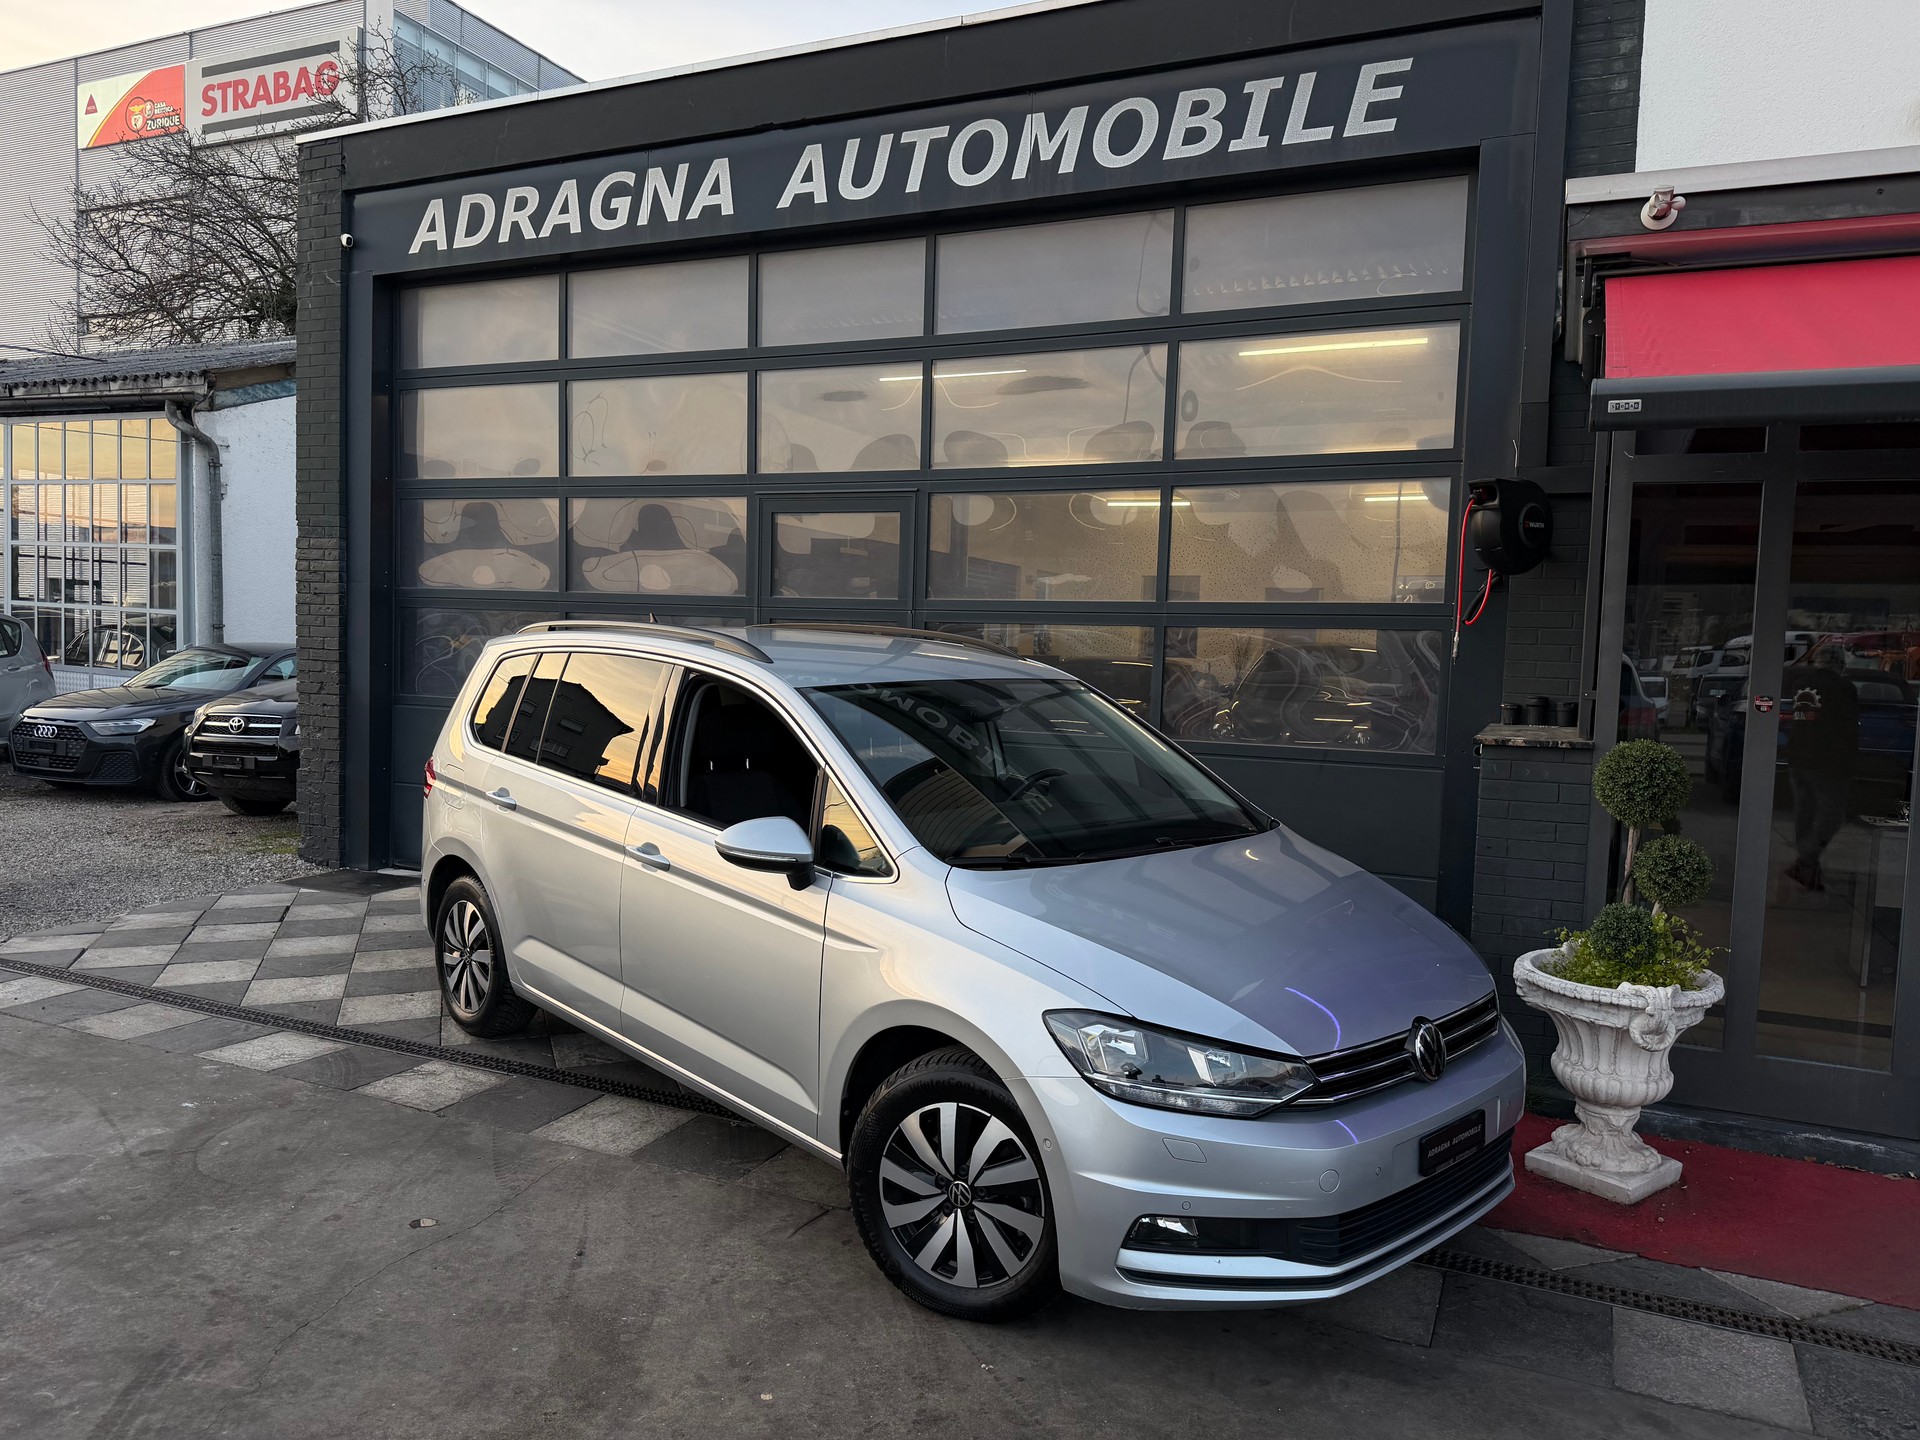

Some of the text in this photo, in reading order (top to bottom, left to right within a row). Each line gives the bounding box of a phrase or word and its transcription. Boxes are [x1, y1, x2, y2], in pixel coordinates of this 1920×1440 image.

[201, 60, 340, 117] STRABAG
[146, 115, 181, 131] ZURIQUE
[408, 58, 1414, 254] ADRAGNA AUTOMOBILE
[1610, 401, 1640, 411] STOBAG
[1427, 1140, 1451, 1158] ADRAGNA
[1452, 1124, 1482, 1146] AUTOMOBILE
